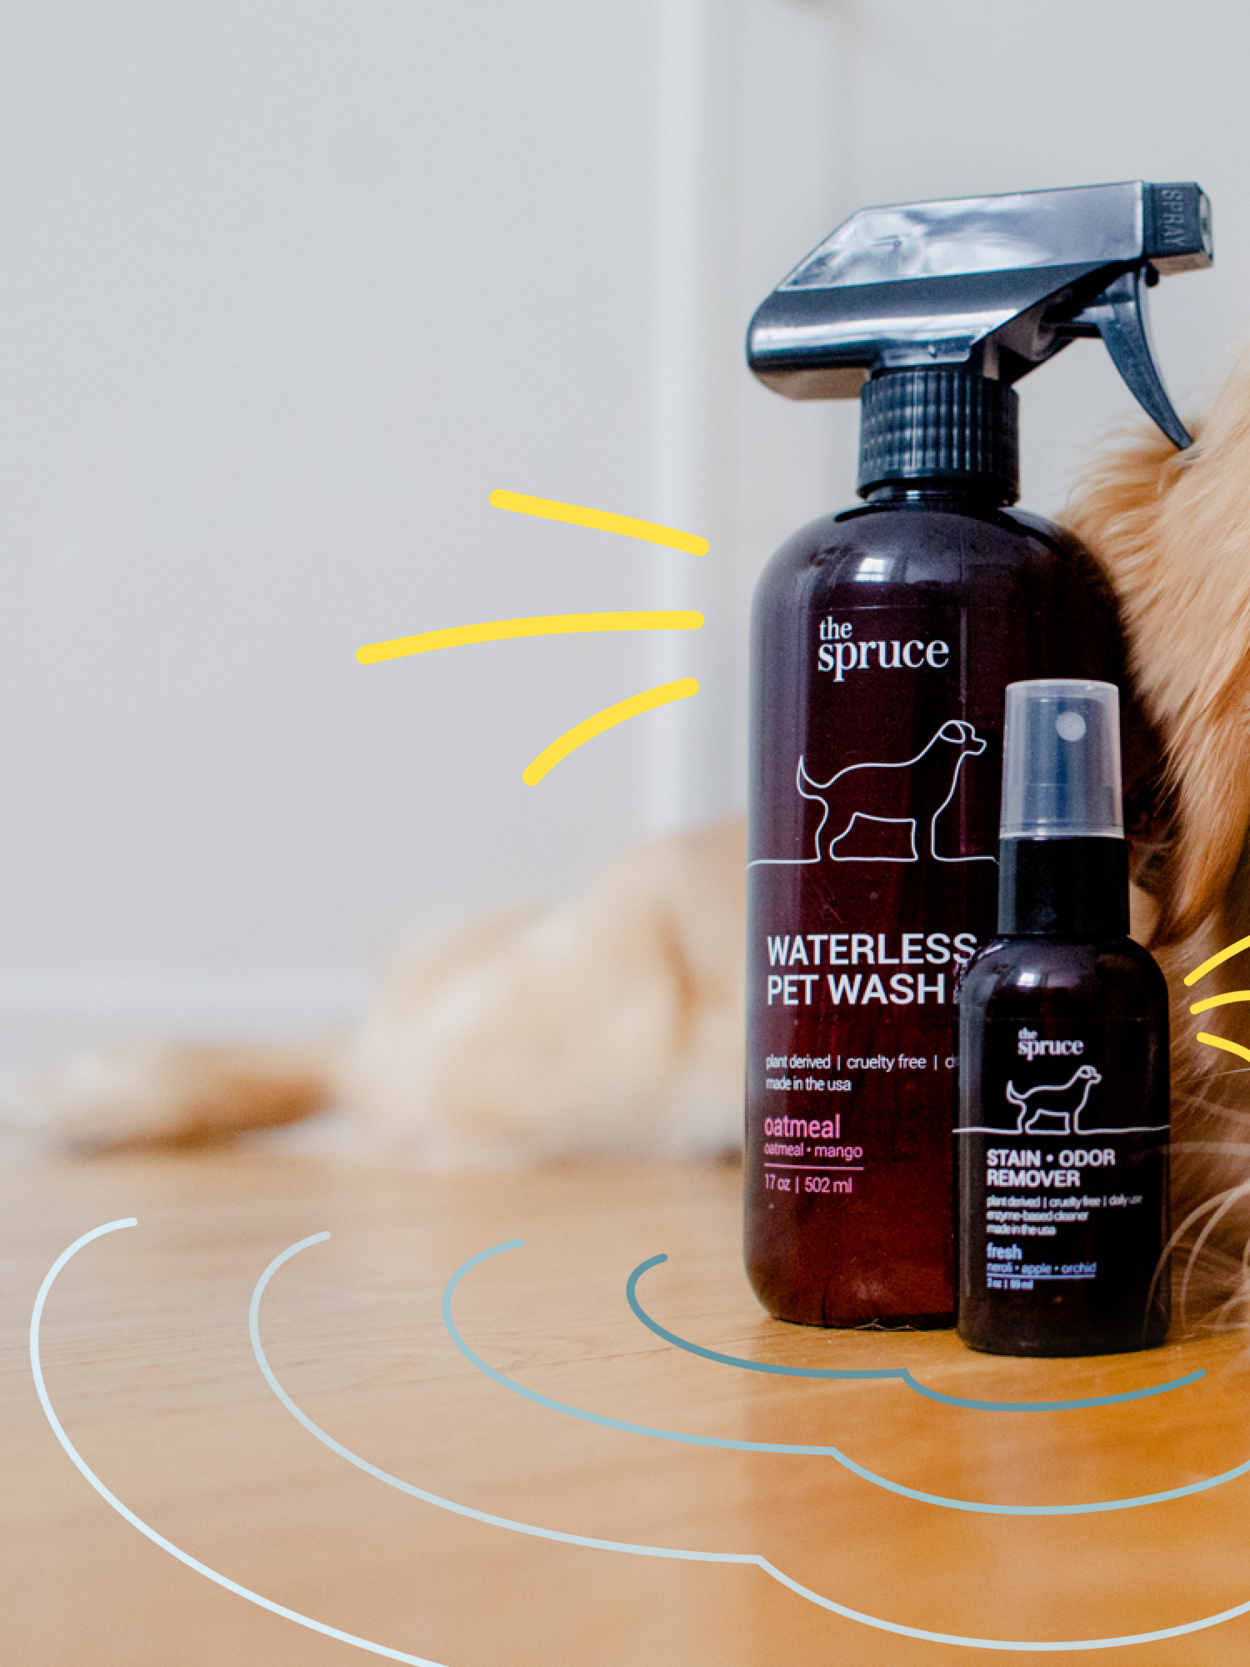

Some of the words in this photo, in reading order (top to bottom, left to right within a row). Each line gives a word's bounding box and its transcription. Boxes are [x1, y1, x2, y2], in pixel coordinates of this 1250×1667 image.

[1161, 189, 1186, 246] SPRAY
[819, 616, 853, 640] the
[817, 639, 949, 683] spruce
[767, 933, 977, 966] WATERLESS
[767, 974, 819, 1005] PET
[827, 973, 945, 1005] WASH
[1018, 1027, 1038, 1040] the
[1018, 1039, 1084, 1061] spruce
[766, 1054, 788, 1071] plant
[789, 1054, 831, 1069] derived
[847, 1054, 895, 1072] cruelty
[898, 1054, 928, 1069] free
[766, 1076, 791, 1090] made
[793, 1076, 804, 1090] in
[805, 1076, 825, 1091] the
[827, 1079, 852, 1091] usa
[764, 1113, 841, 1139] oatmeal
[764, 1142, 804, 1157] oatmeal
[814, 1146, 863, 1162] mango
[986, 1148, 1042, 1167] STAIN
[1058, 1148, 1116, 1167] ODOR
[764, 1173, 776, 1189] 17
[778, 1178, 791, 1191] oz
[805, 1176, 830, 1193] 502
[833, 1177, 852, 1193] ml
[986, 1168, 1081, 1187] REMOVER
[1081, 1194, 1101, 1207] free
[986, 1241, 1022, 1261] fresh
[1021, 1262, 1053, 1276] apple
[1060, 1262, 1097, 1273] orchid
